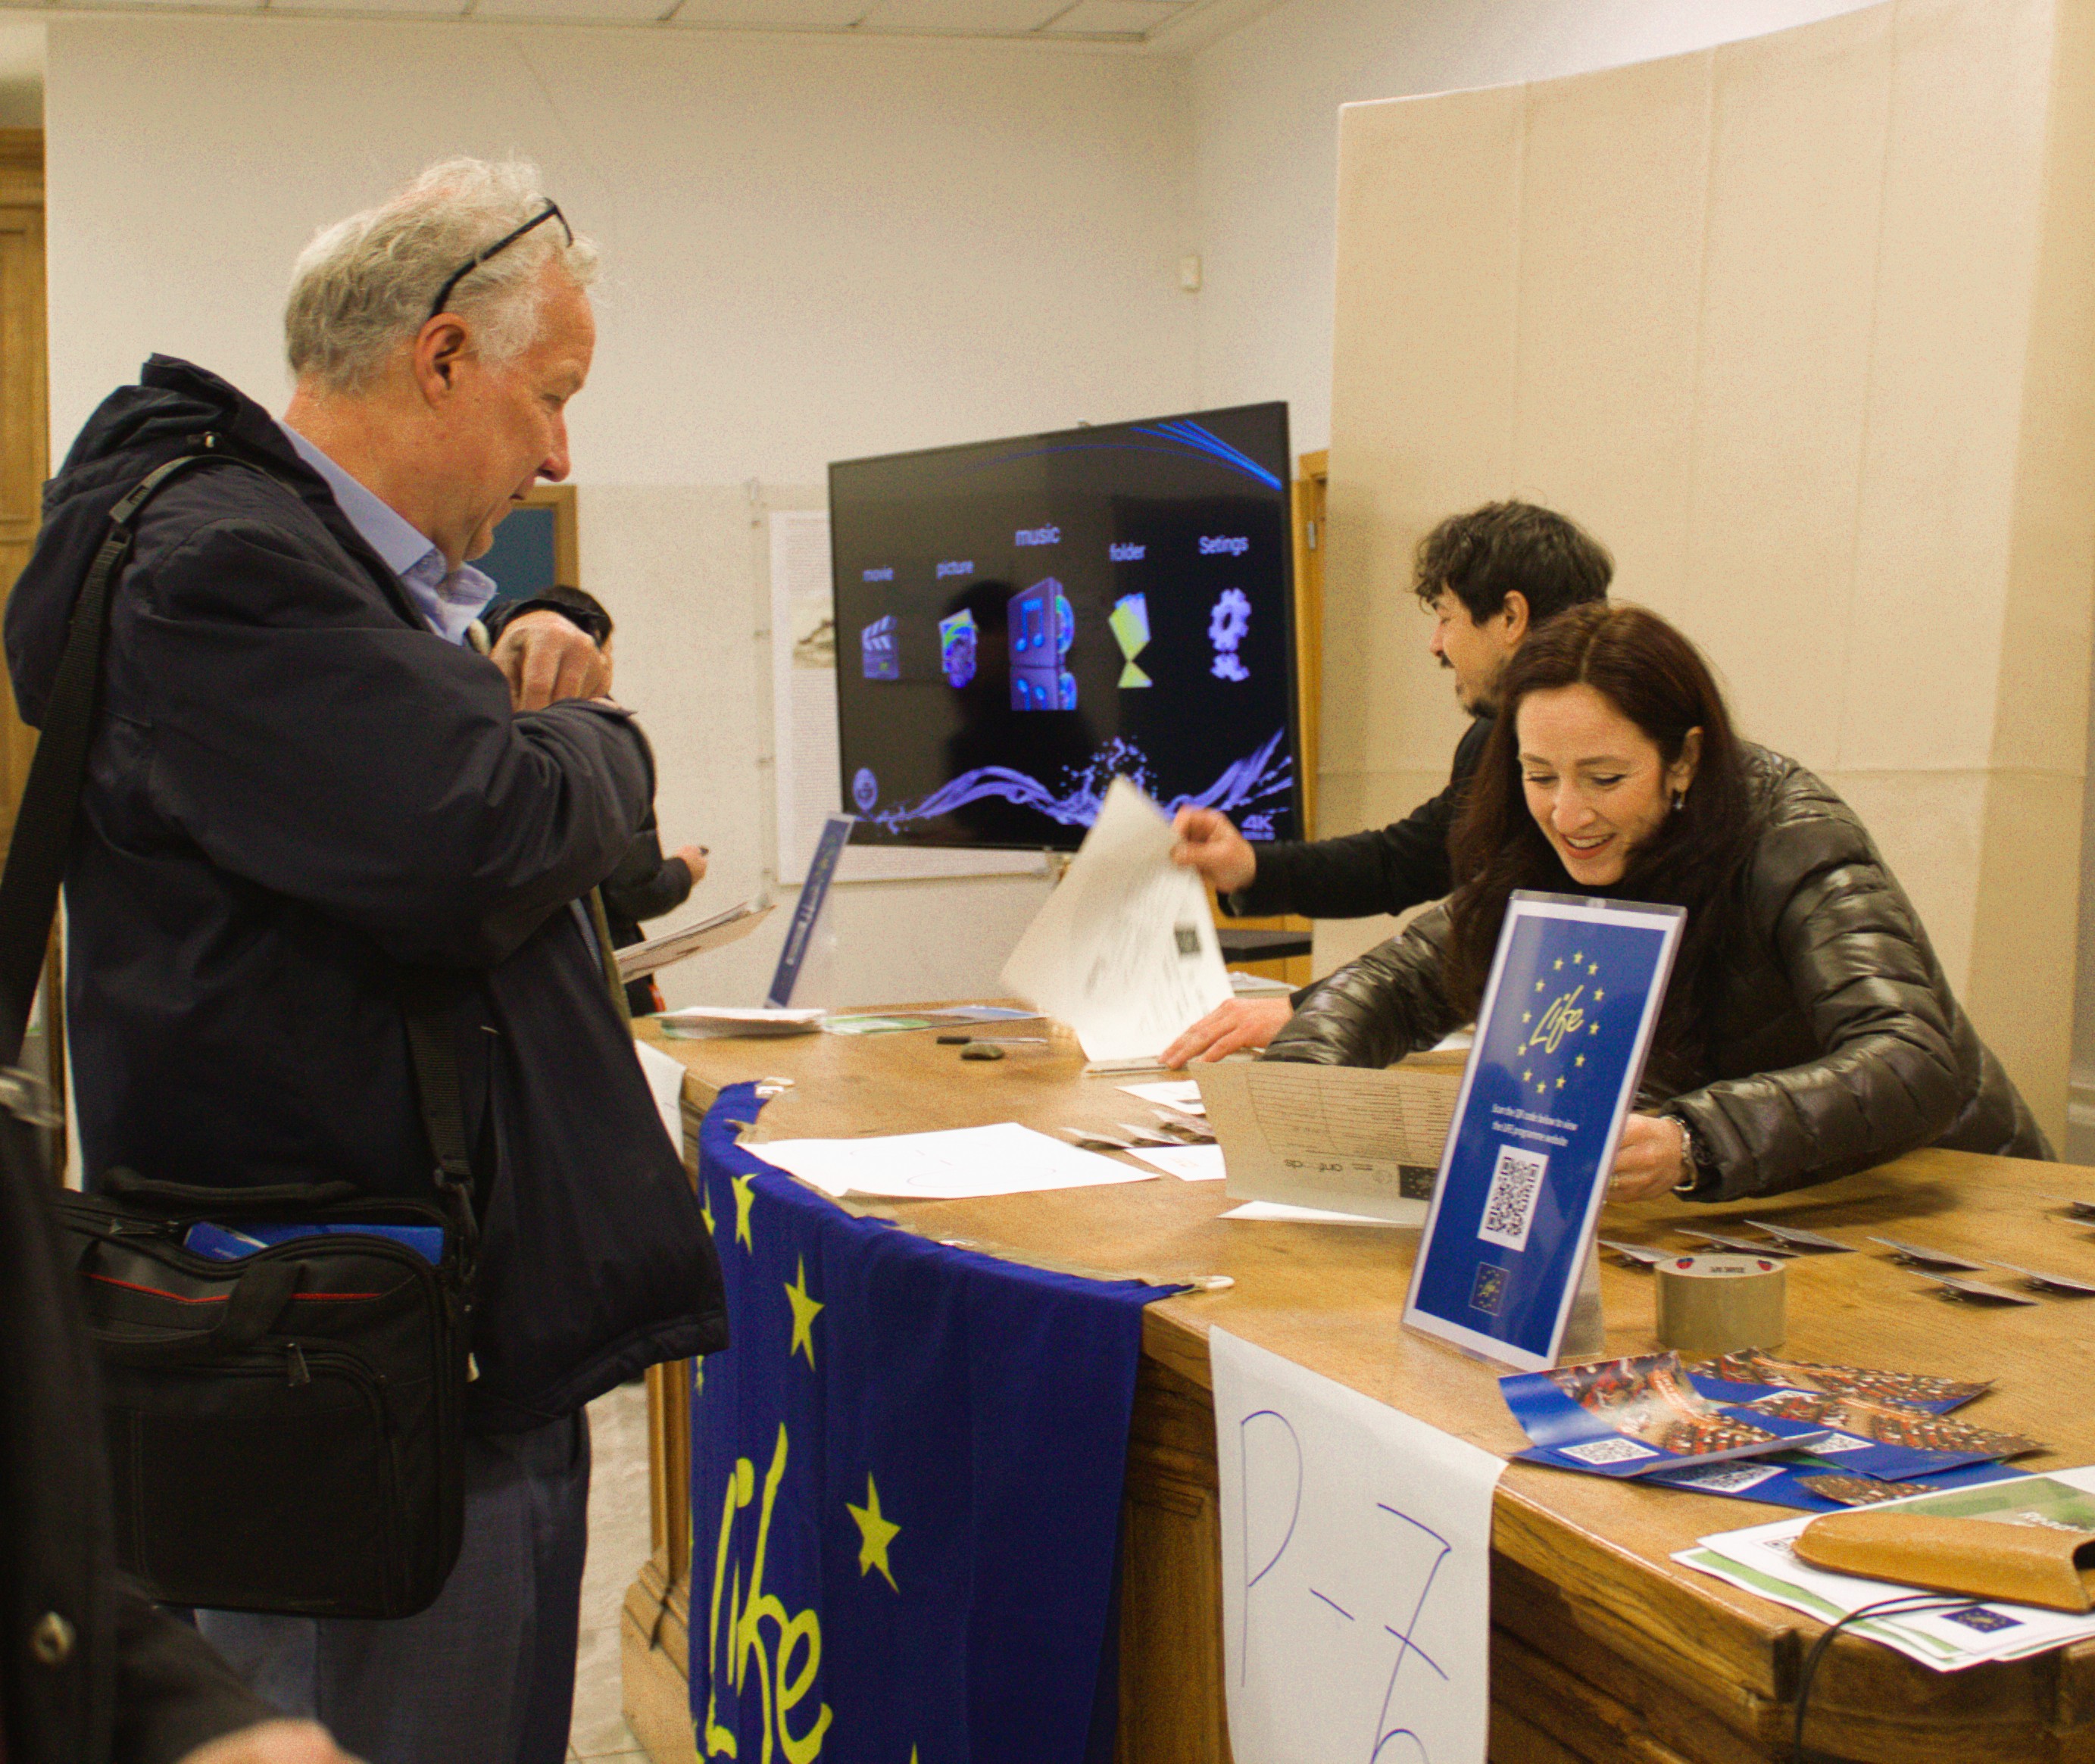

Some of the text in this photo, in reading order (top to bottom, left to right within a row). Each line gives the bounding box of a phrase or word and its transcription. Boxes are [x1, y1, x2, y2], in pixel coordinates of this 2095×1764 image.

[1015, 523, 1060, 546] music
[1110, 542, 1146, 562] folder
[1241, 814, 1274, 831] 4K
[1529, 985, 1584, 1054] Life
